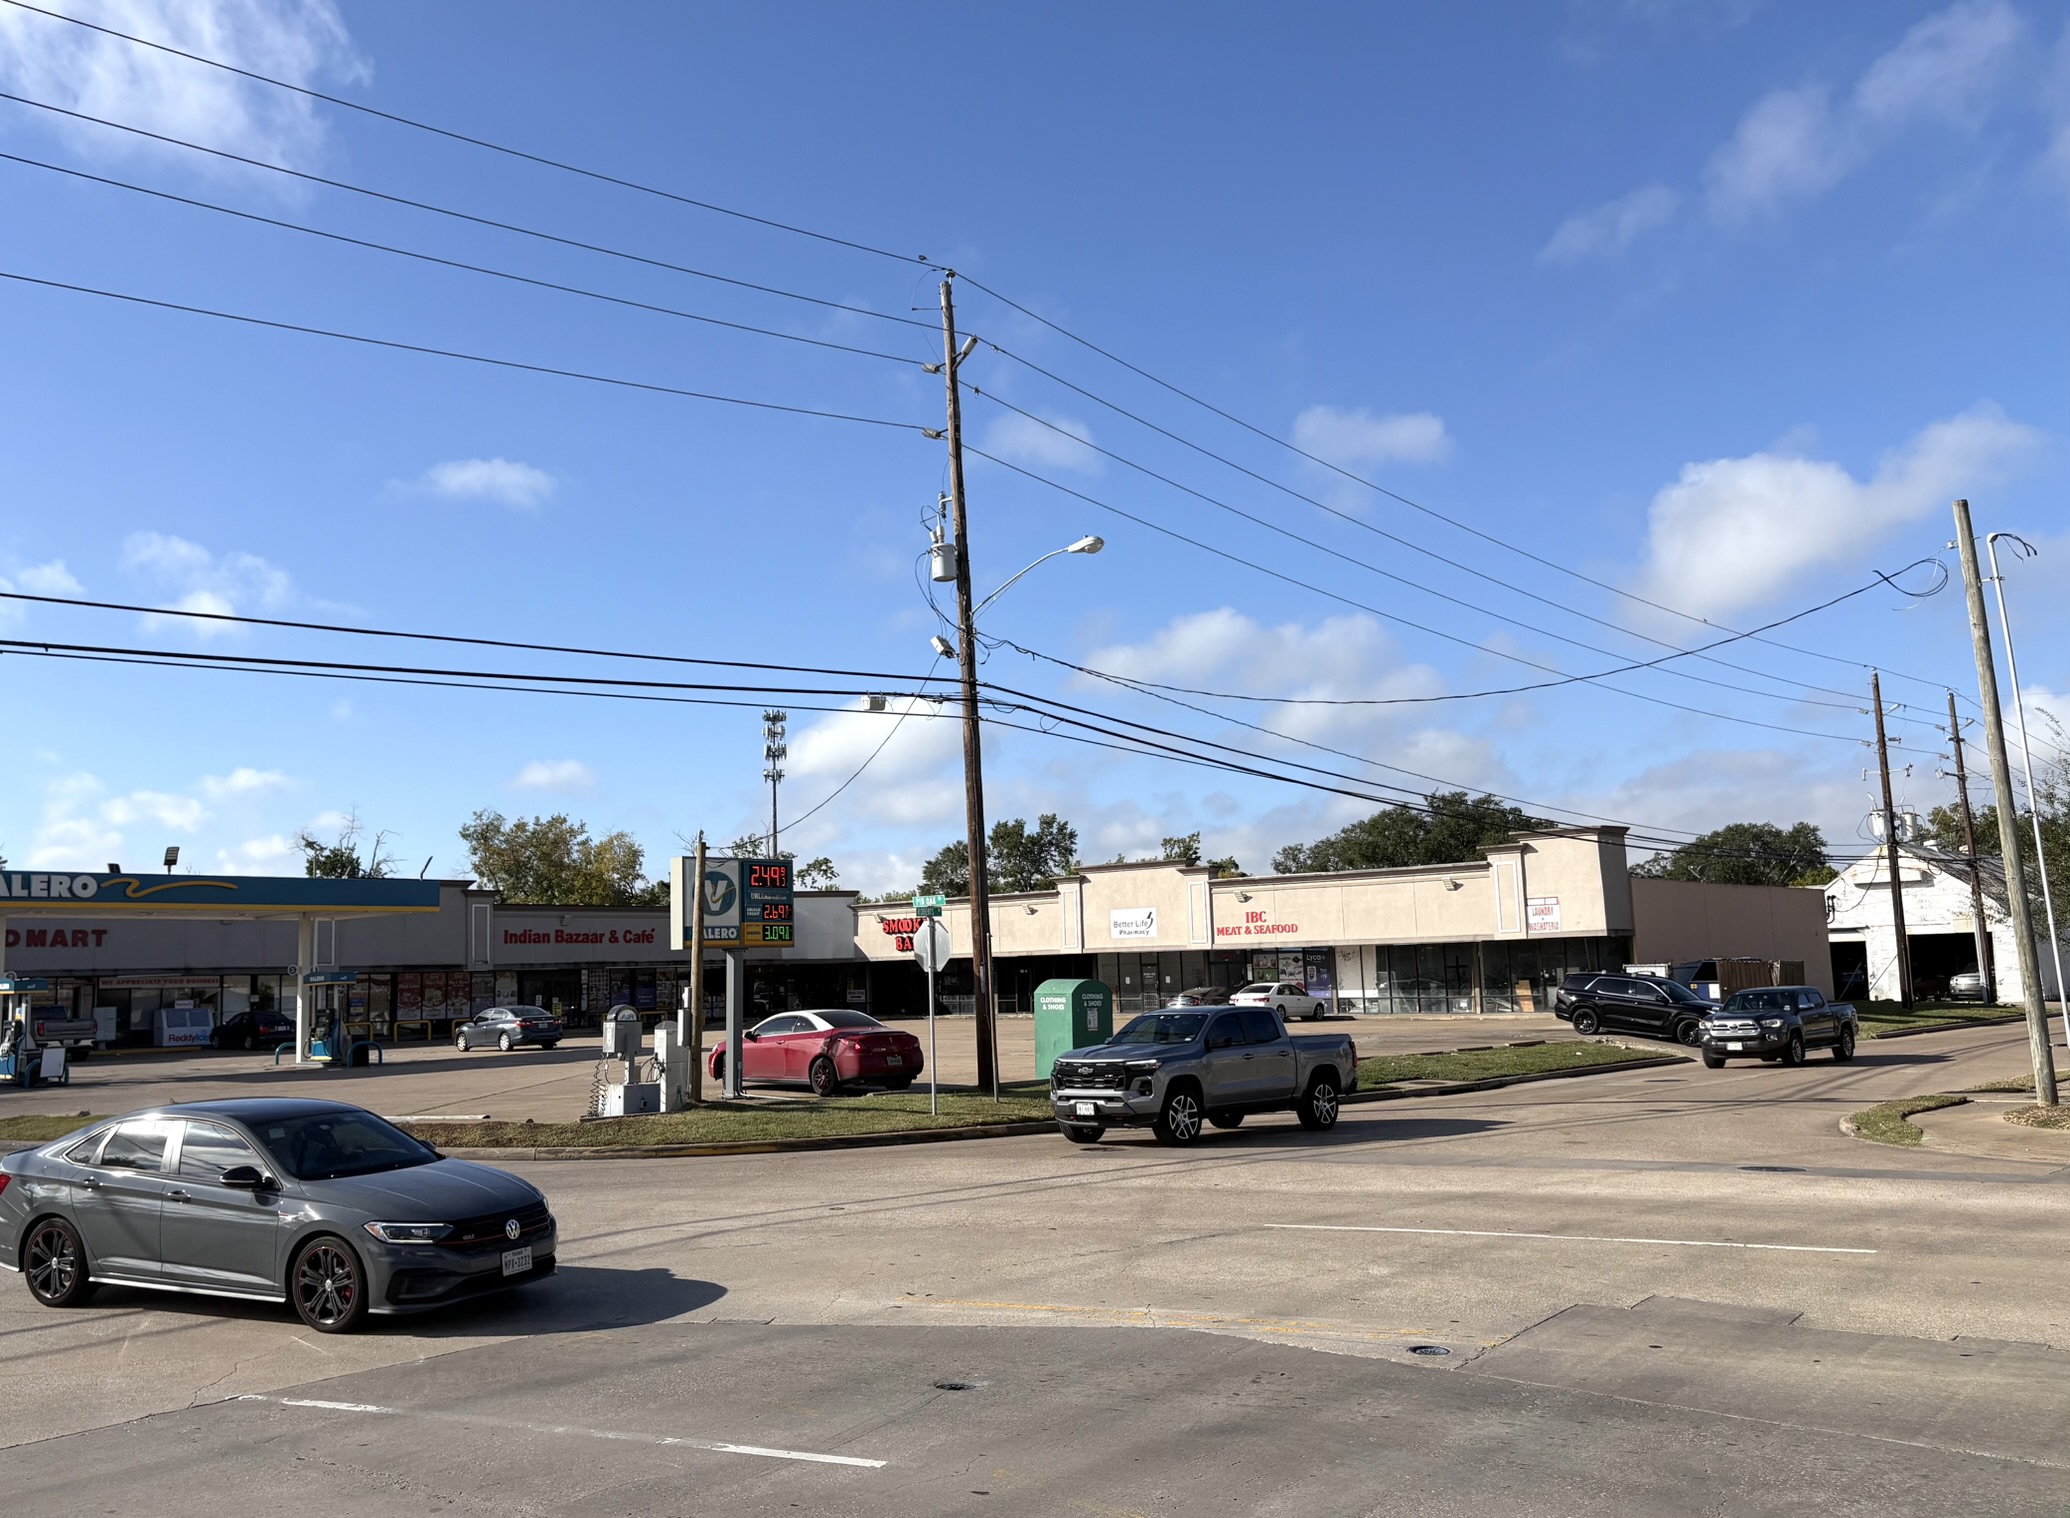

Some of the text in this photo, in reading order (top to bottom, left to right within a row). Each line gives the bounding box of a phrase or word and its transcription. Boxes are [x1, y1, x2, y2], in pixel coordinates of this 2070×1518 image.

[1245, 911, 1267, 923] IBC
[1532, 906, 1553, 916] LAUNDRY
[1113, 919, 1148, 928] Better Life
[1216, 923, 1298, 936] MEAT & SEAFOOD
[26, 929, 107, 948] MART
[503, 928, 655, 944] Indian Bazaar & Café
[1306, 954, 1321, 962] Lyca
